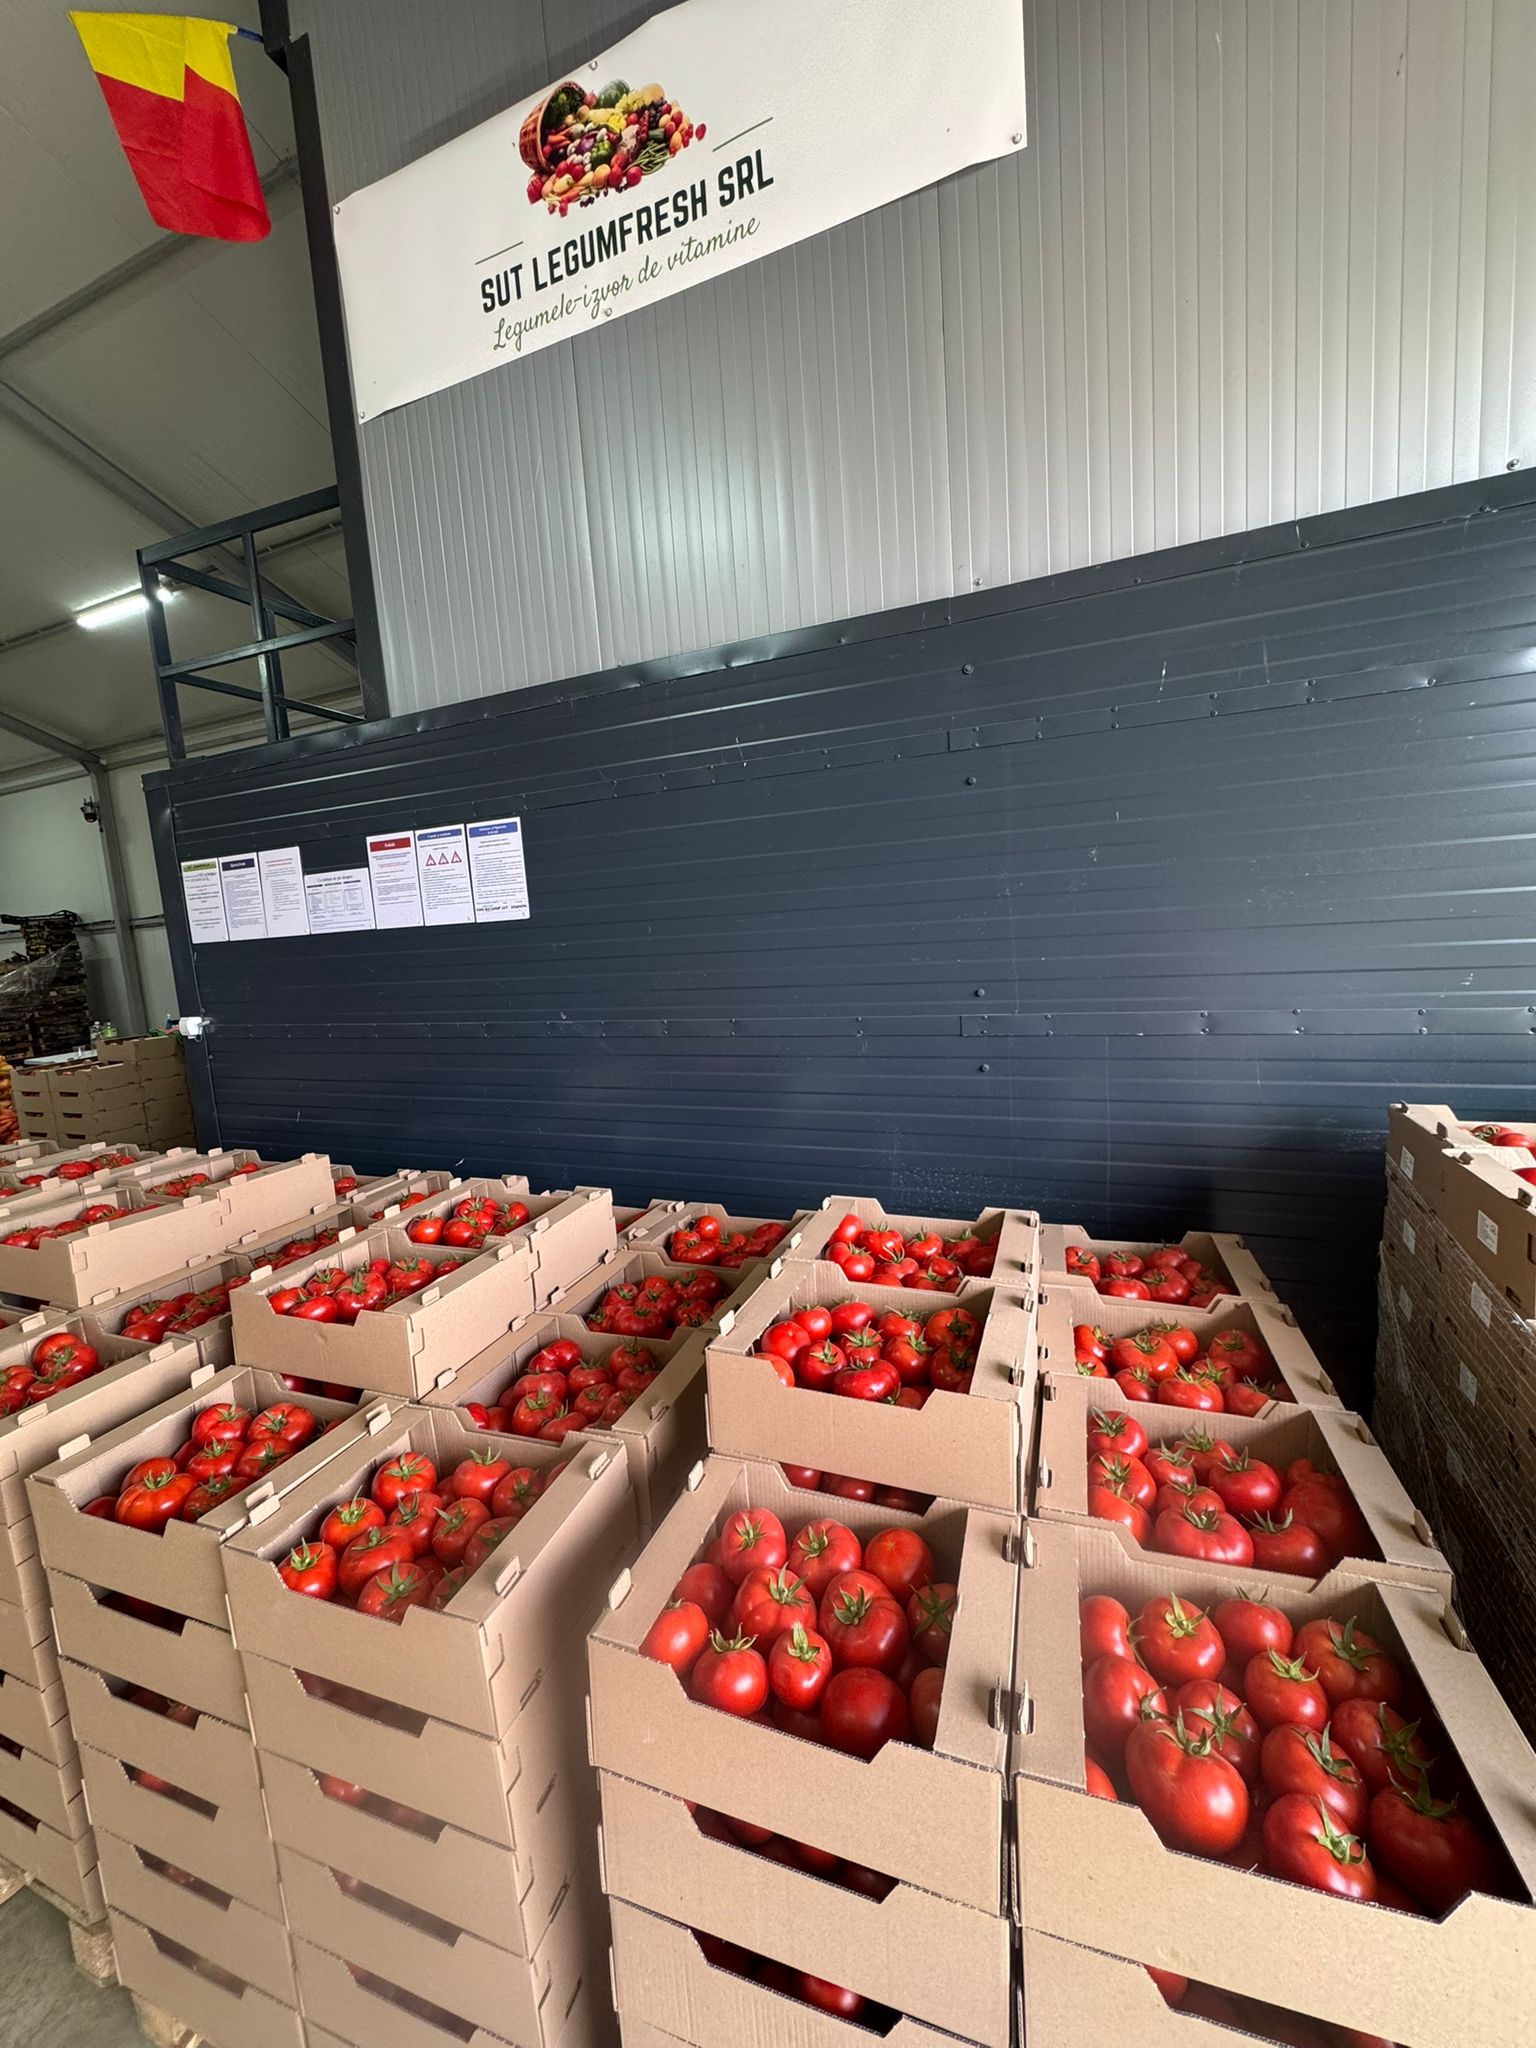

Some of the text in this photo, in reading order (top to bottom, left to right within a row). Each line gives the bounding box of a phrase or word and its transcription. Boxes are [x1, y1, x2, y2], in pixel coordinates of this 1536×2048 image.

[481, 149, 774, 313] SUT LEGUMFRESH SRL
[494, 217, 760, 351] Legumele-izvor de vitamine
